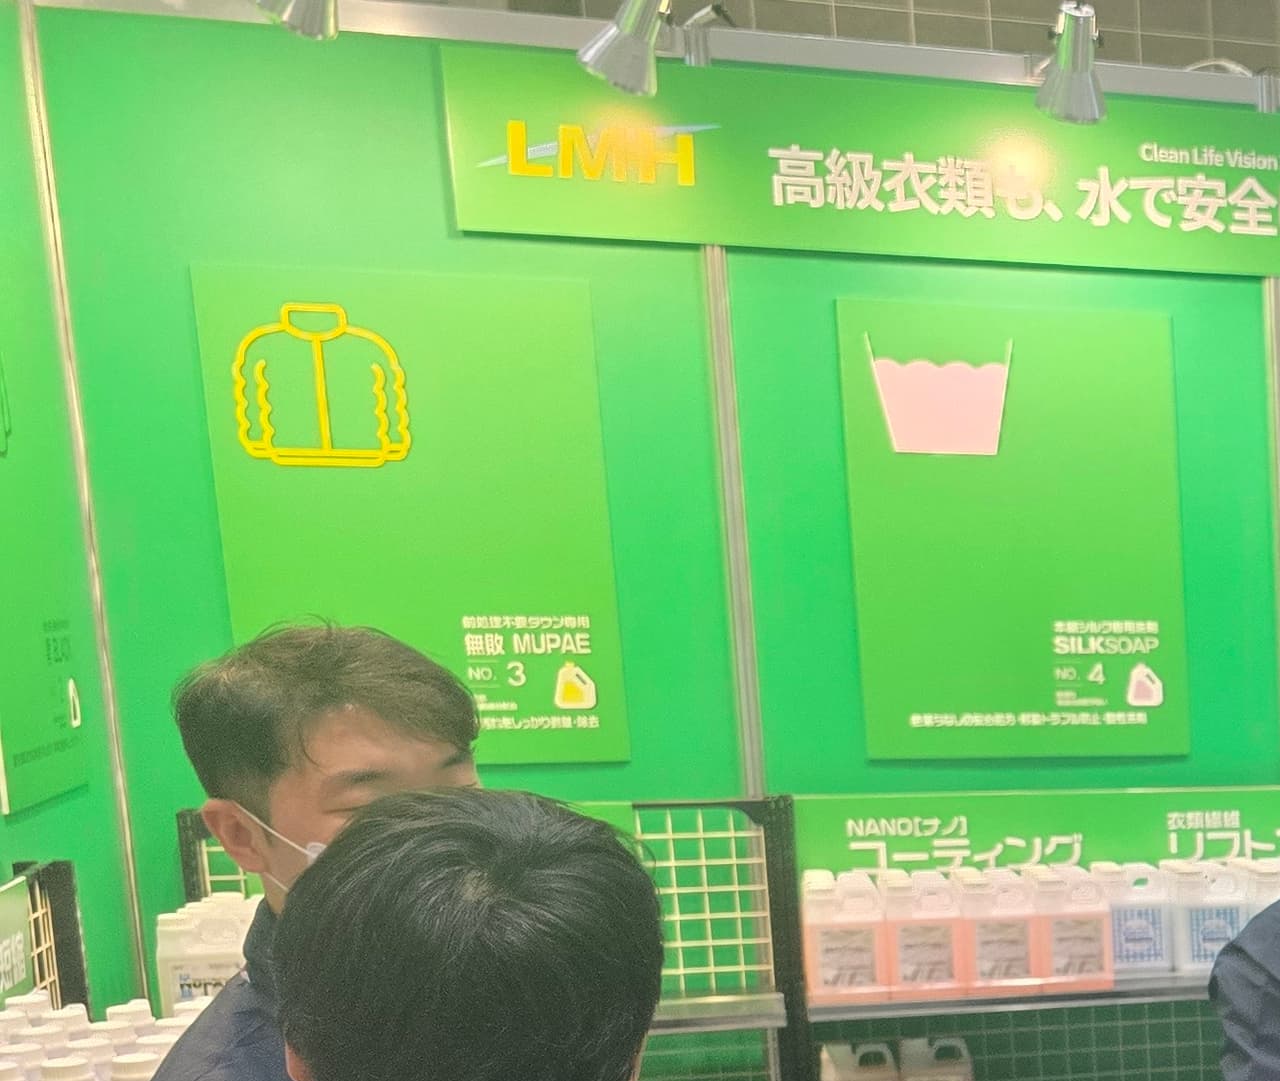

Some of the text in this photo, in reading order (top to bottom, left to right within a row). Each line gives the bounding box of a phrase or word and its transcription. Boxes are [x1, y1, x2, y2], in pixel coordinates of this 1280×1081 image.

[507, 119, 697, 187] LMH
[1140, 143, 1190, 165] Clean
[1192, 146, 1226, 169] Life
[1227, 149, 1278, 171] Vision
[513, 633, 592, 655] MUPAE
[1053, 636, 1159, 655] SILKSOAP
[468, 661, 526, 687] NO. 3
[1055, 663, 1105, 684] NO. 4
[849, 833, 1083, 872] コーティング
